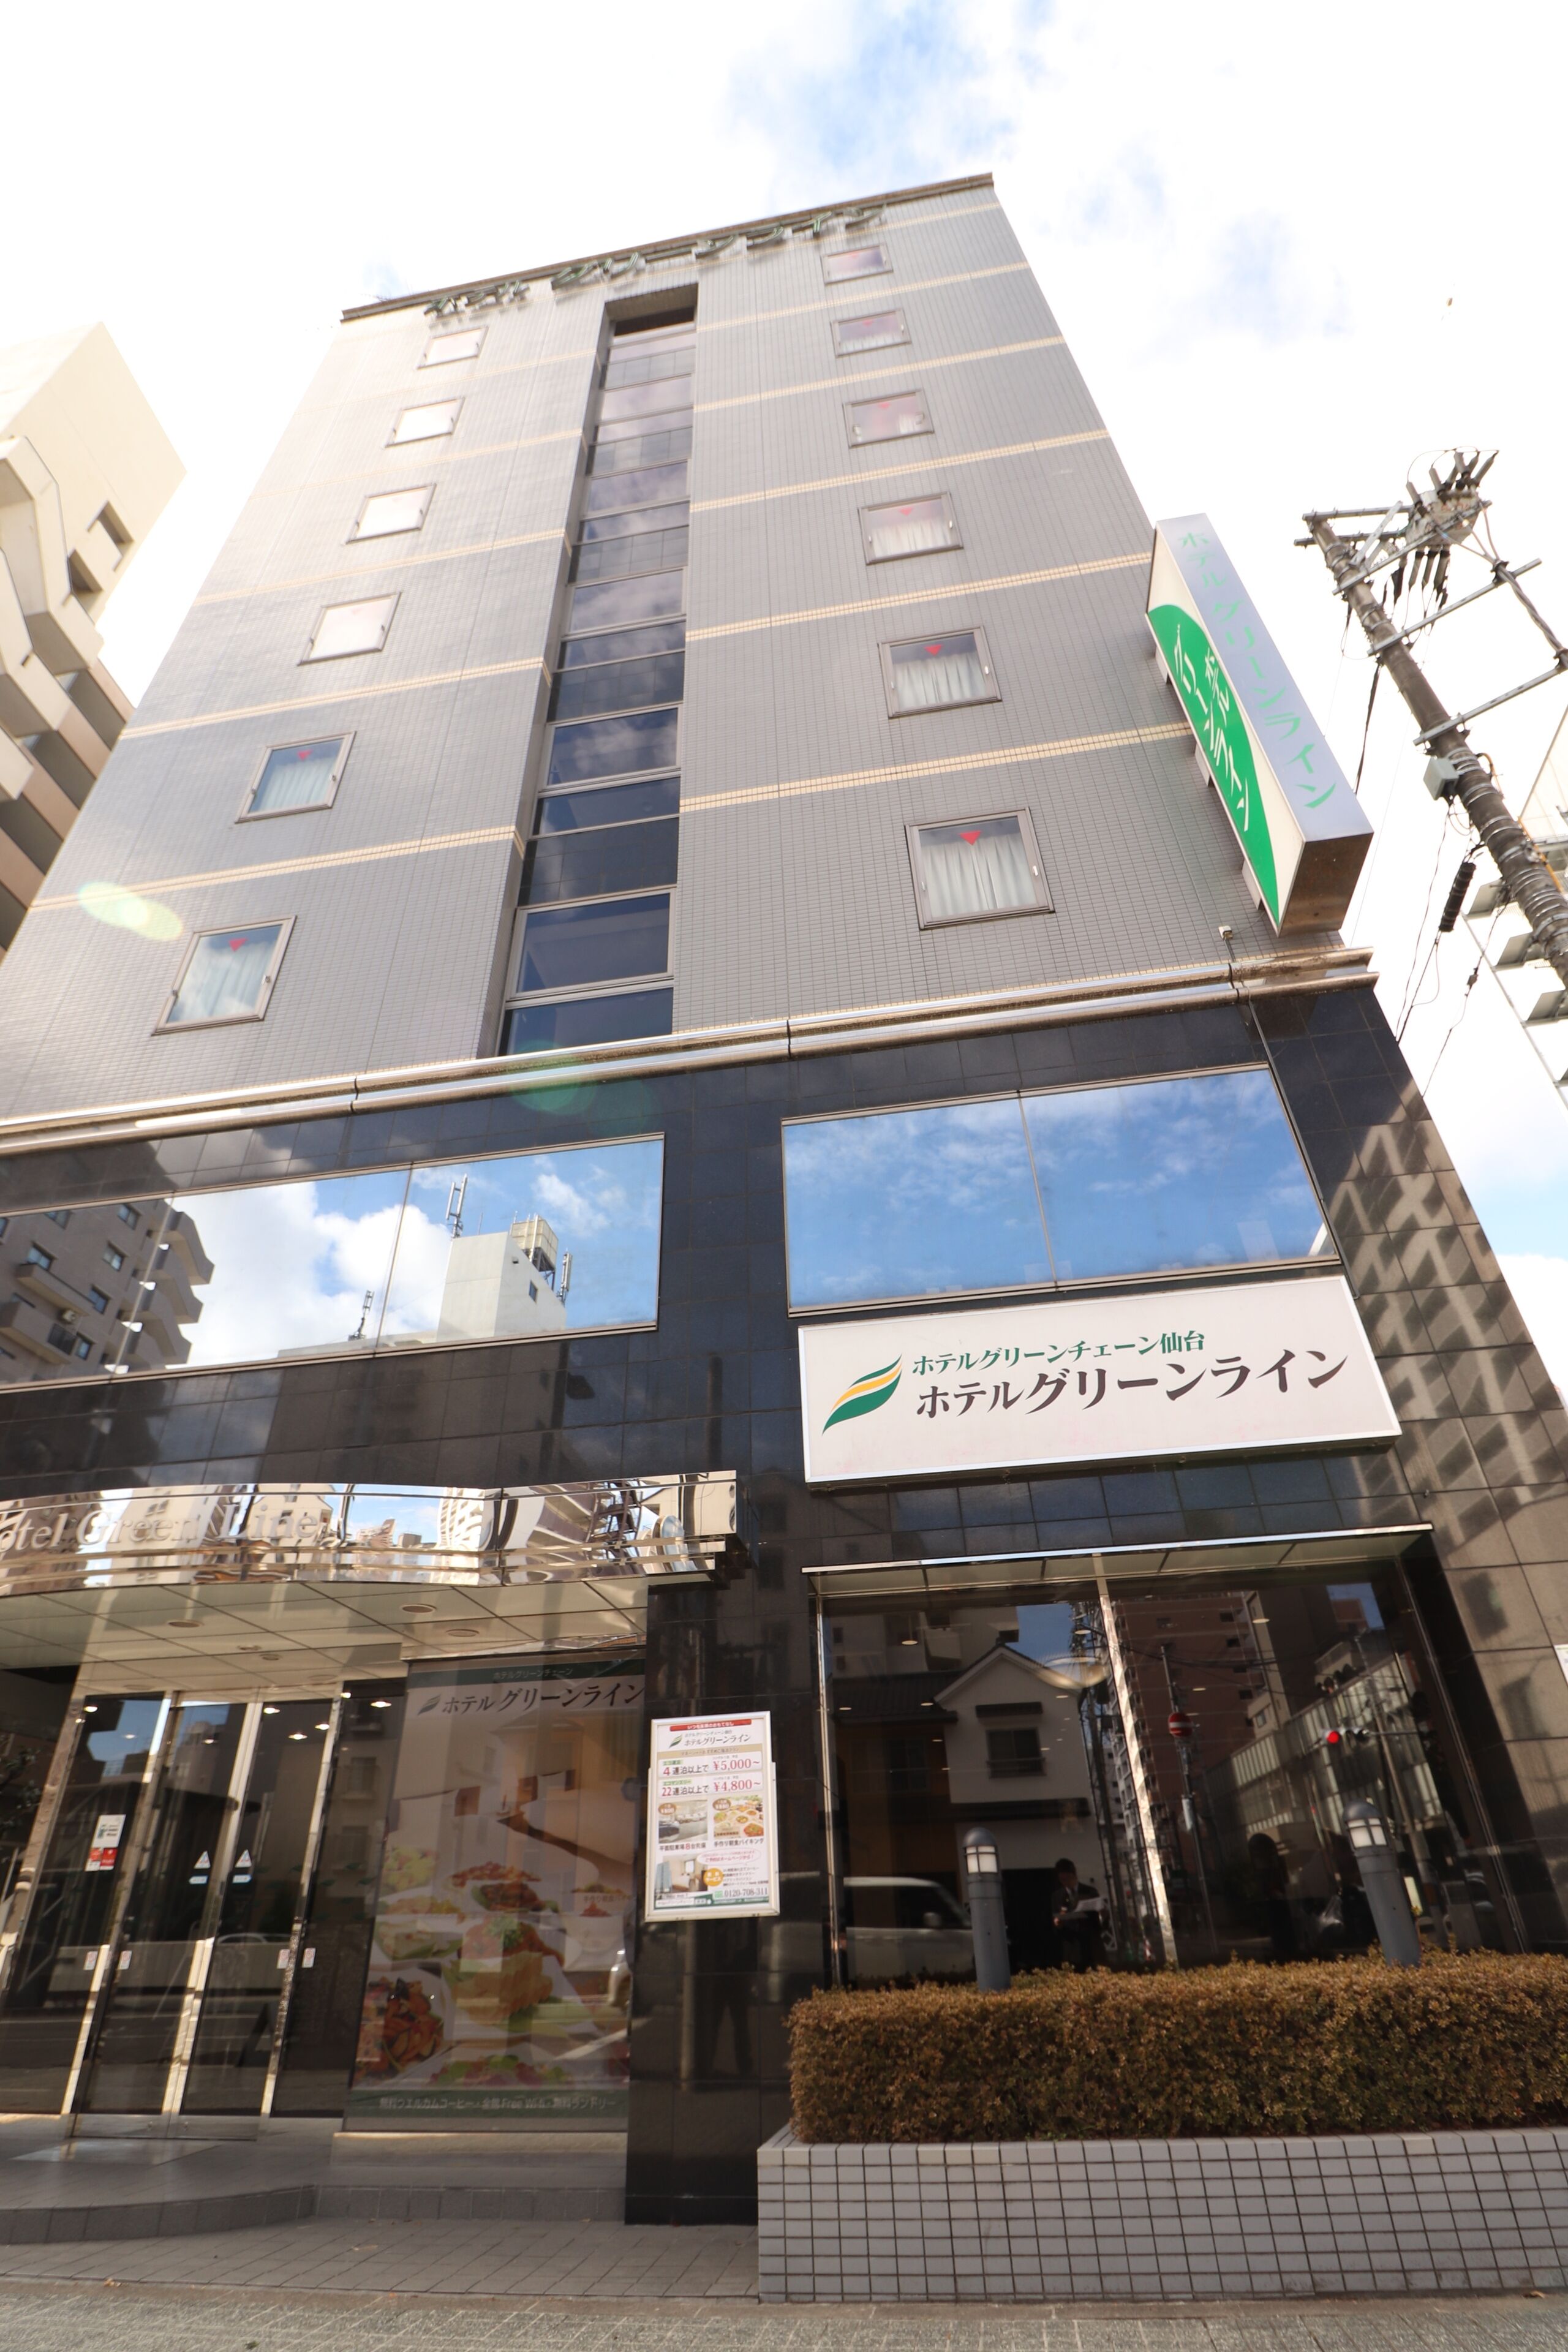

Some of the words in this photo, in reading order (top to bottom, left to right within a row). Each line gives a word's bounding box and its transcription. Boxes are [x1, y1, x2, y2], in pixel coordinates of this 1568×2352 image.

[1177, 532, 1337, 809] ホテルグリーンライン
[1204, 647, 1230, 728] ホテル
[912, 1330, 1205, 1377] ホテルグリーンチェーン仙台
[915, 1349, 1349, 1419] ホテルグリーンライン
[76, 1510, 200, 1545] Green
[215, 1504, 317, 1539] Line
[494, 1668, 573, 1680] ホテルグリーンチェーン
[442, 1683, 645, 1714] ホテルグリーンライン
[684, 1734, 751, 1746] ホテルグリーンライン
